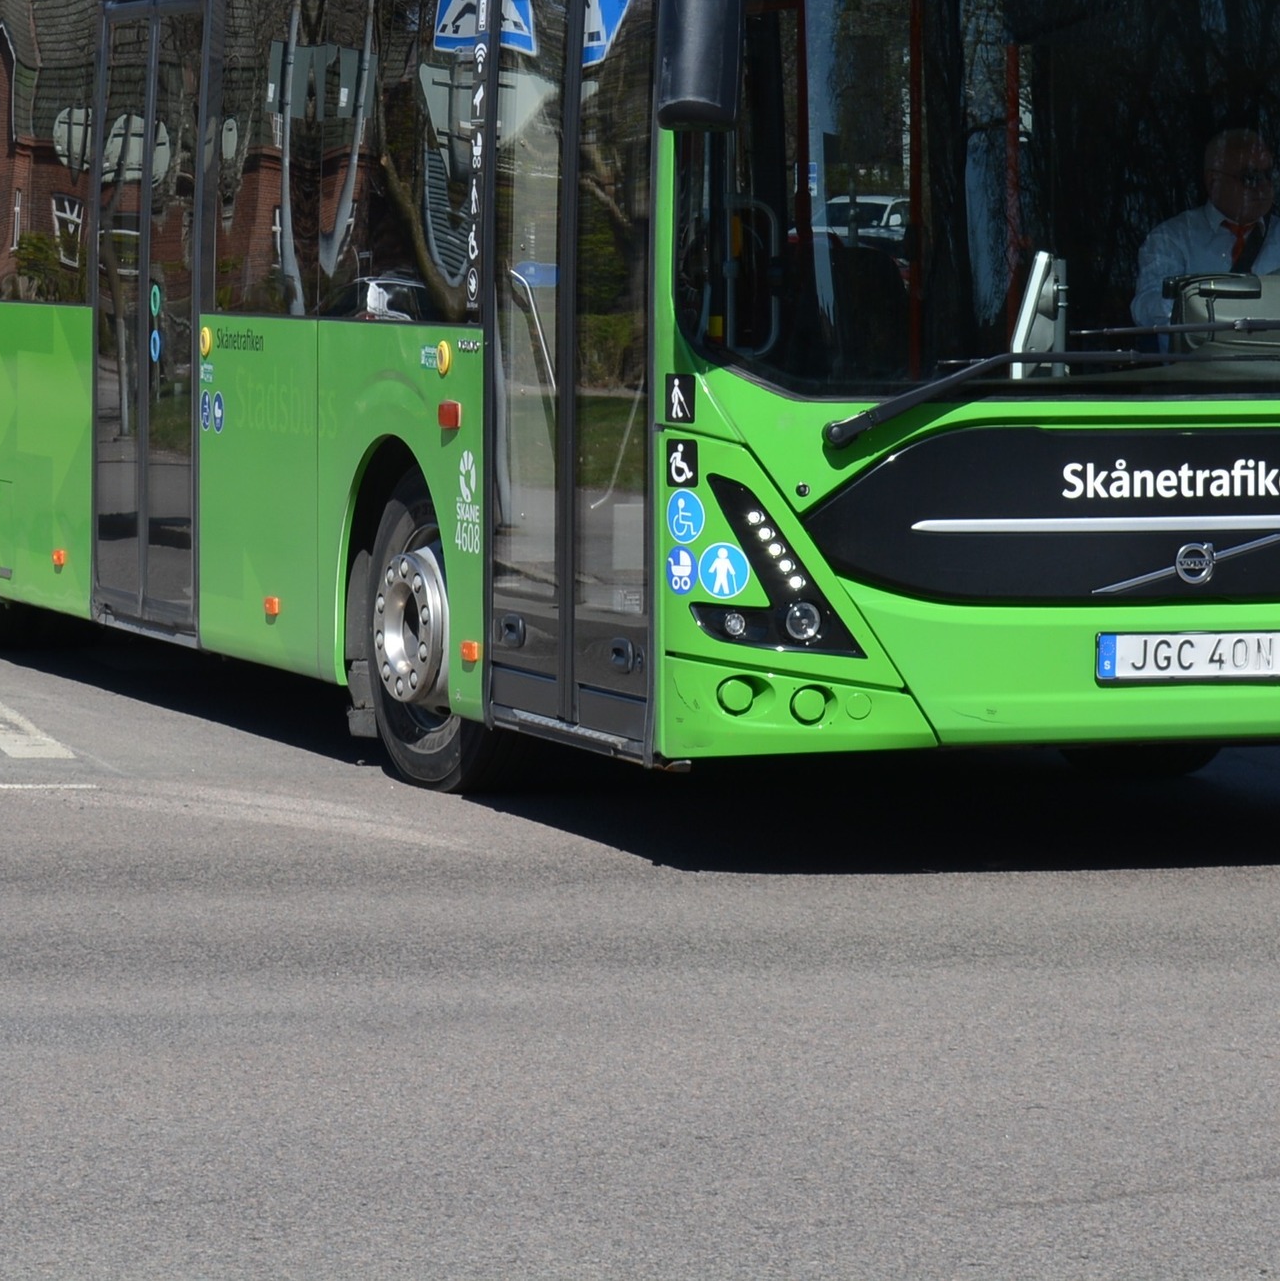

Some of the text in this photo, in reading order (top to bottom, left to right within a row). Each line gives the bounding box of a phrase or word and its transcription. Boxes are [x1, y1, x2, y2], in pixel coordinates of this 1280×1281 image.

[216, 326, 264, 352] Skånetrafiken
[455, 521, 480, 555] 4608
[1131, 639, 1195, 671] JGC
